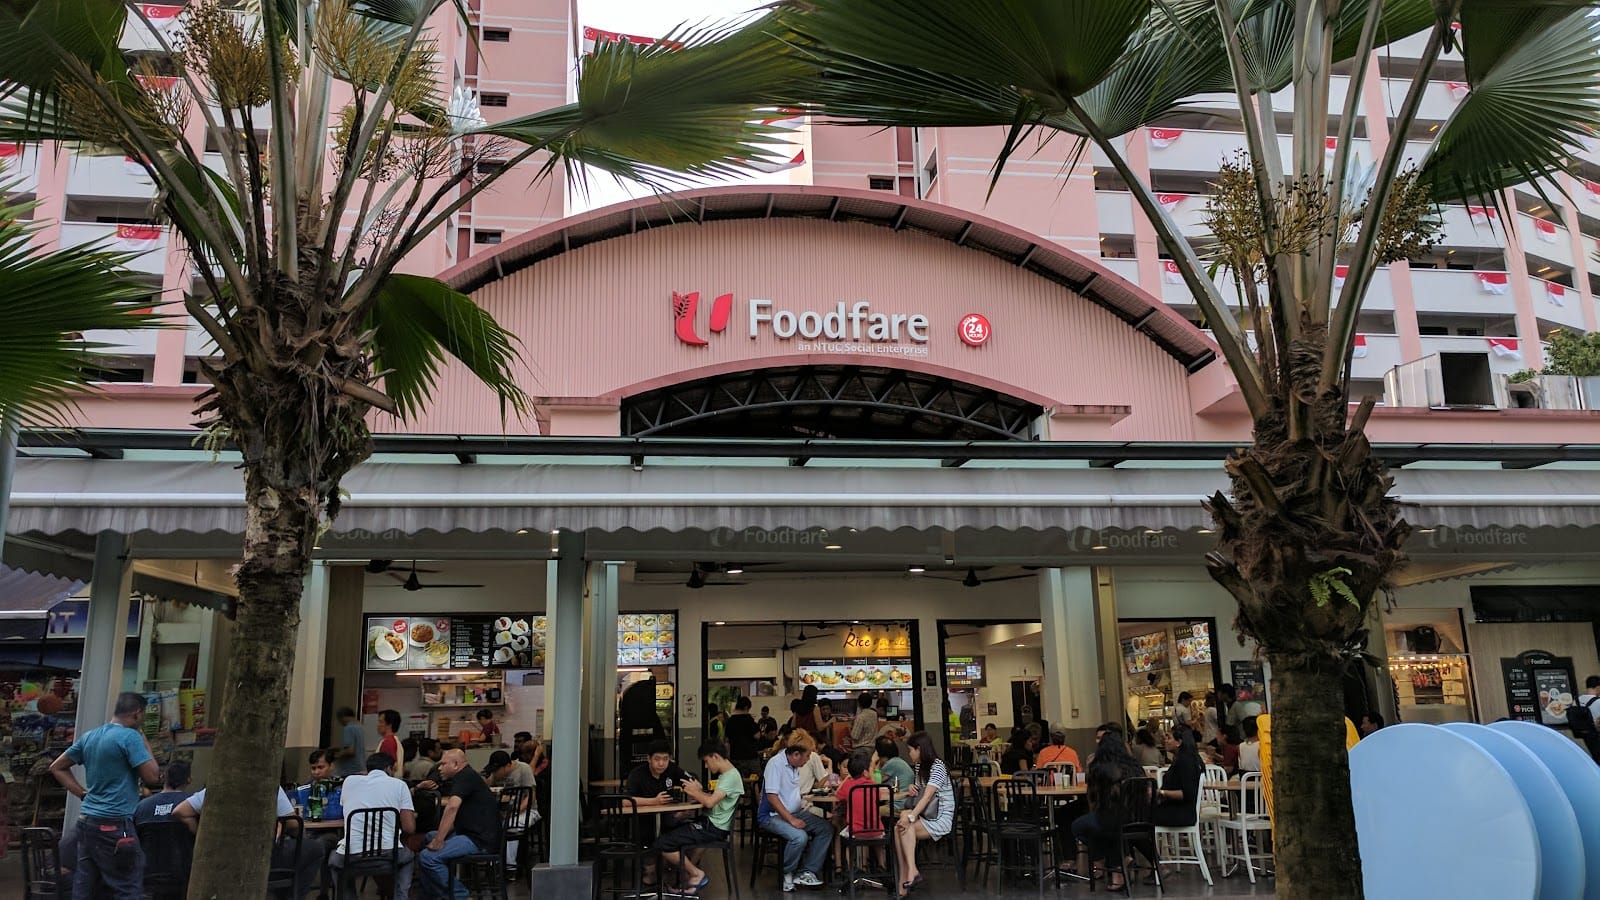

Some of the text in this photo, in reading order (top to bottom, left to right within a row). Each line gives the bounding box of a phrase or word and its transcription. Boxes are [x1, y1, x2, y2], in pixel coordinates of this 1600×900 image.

[749, 299, 929, 341] Foodfare
[968, 323, 983, 334] 24
[798, 343, 928, 357] an NTUC Social Enterprise
[744, 527, 829, 545] Foodfare
[1101, 530, 1178, 548] Foodfare
[1455, 528, 1528, 545] Foodfare
[843, 631, 870, 648] Rice
